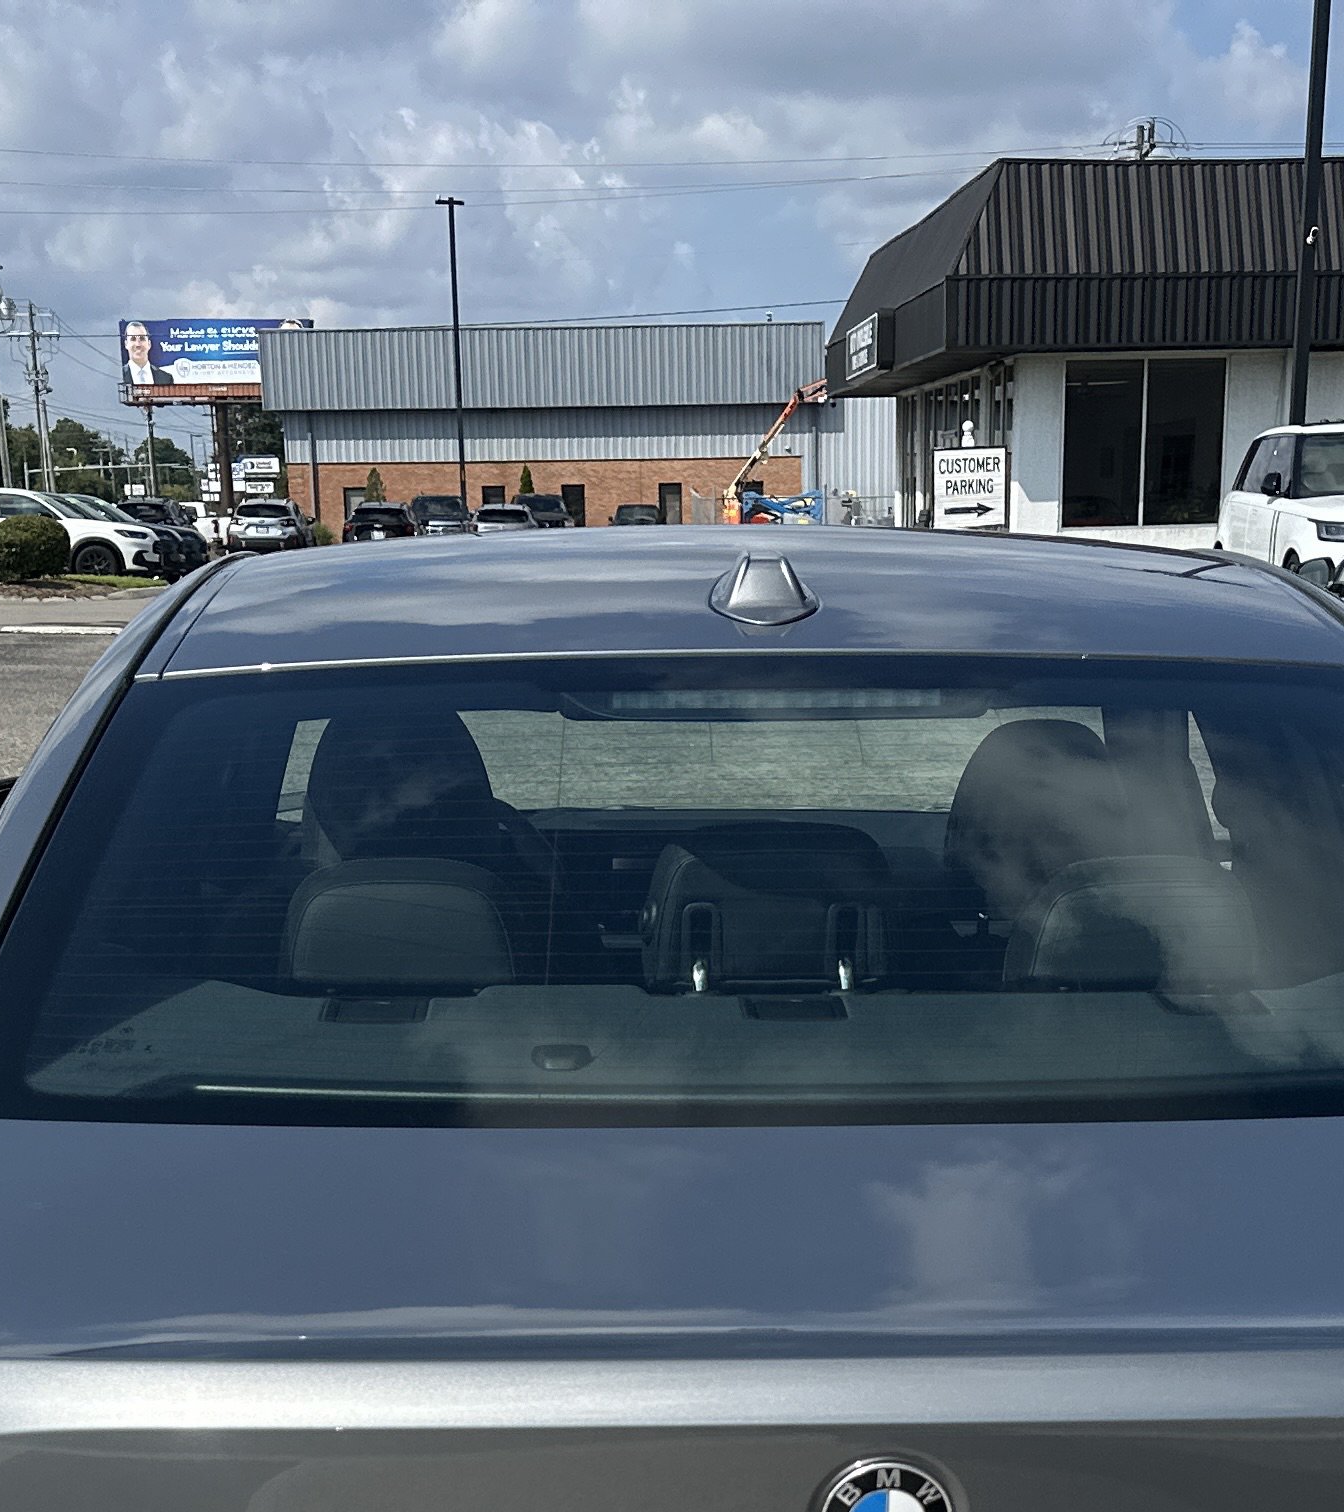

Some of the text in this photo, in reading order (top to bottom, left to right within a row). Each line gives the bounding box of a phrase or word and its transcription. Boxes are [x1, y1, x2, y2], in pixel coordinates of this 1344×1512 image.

[169, 327, 205, 338] Market
[160, 341, 183, 352] Your
[184, 341, 220, 354] Lawyer
[938, 456, 1001, 474] CUSTOMER
[945, 478, 994, 496] PARKING
[836, 1468, 942, 1507] BMW
